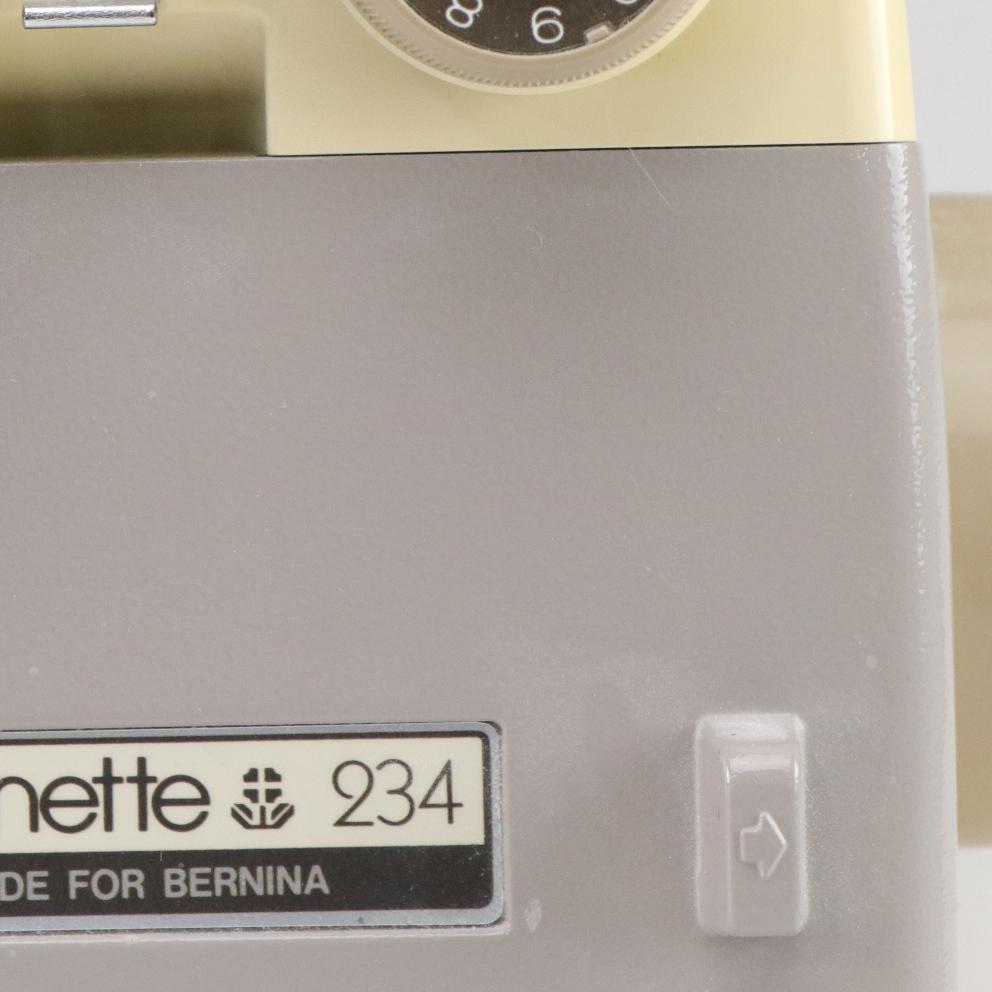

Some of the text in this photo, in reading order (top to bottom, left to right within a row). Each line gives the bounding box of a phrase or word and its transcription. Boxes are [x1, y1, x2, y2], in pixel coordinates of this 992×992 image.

[331, 758, 464, 828] 234
[68, 868, 146, 901] FOR
[164, 863, 331, 898] BERNINA
